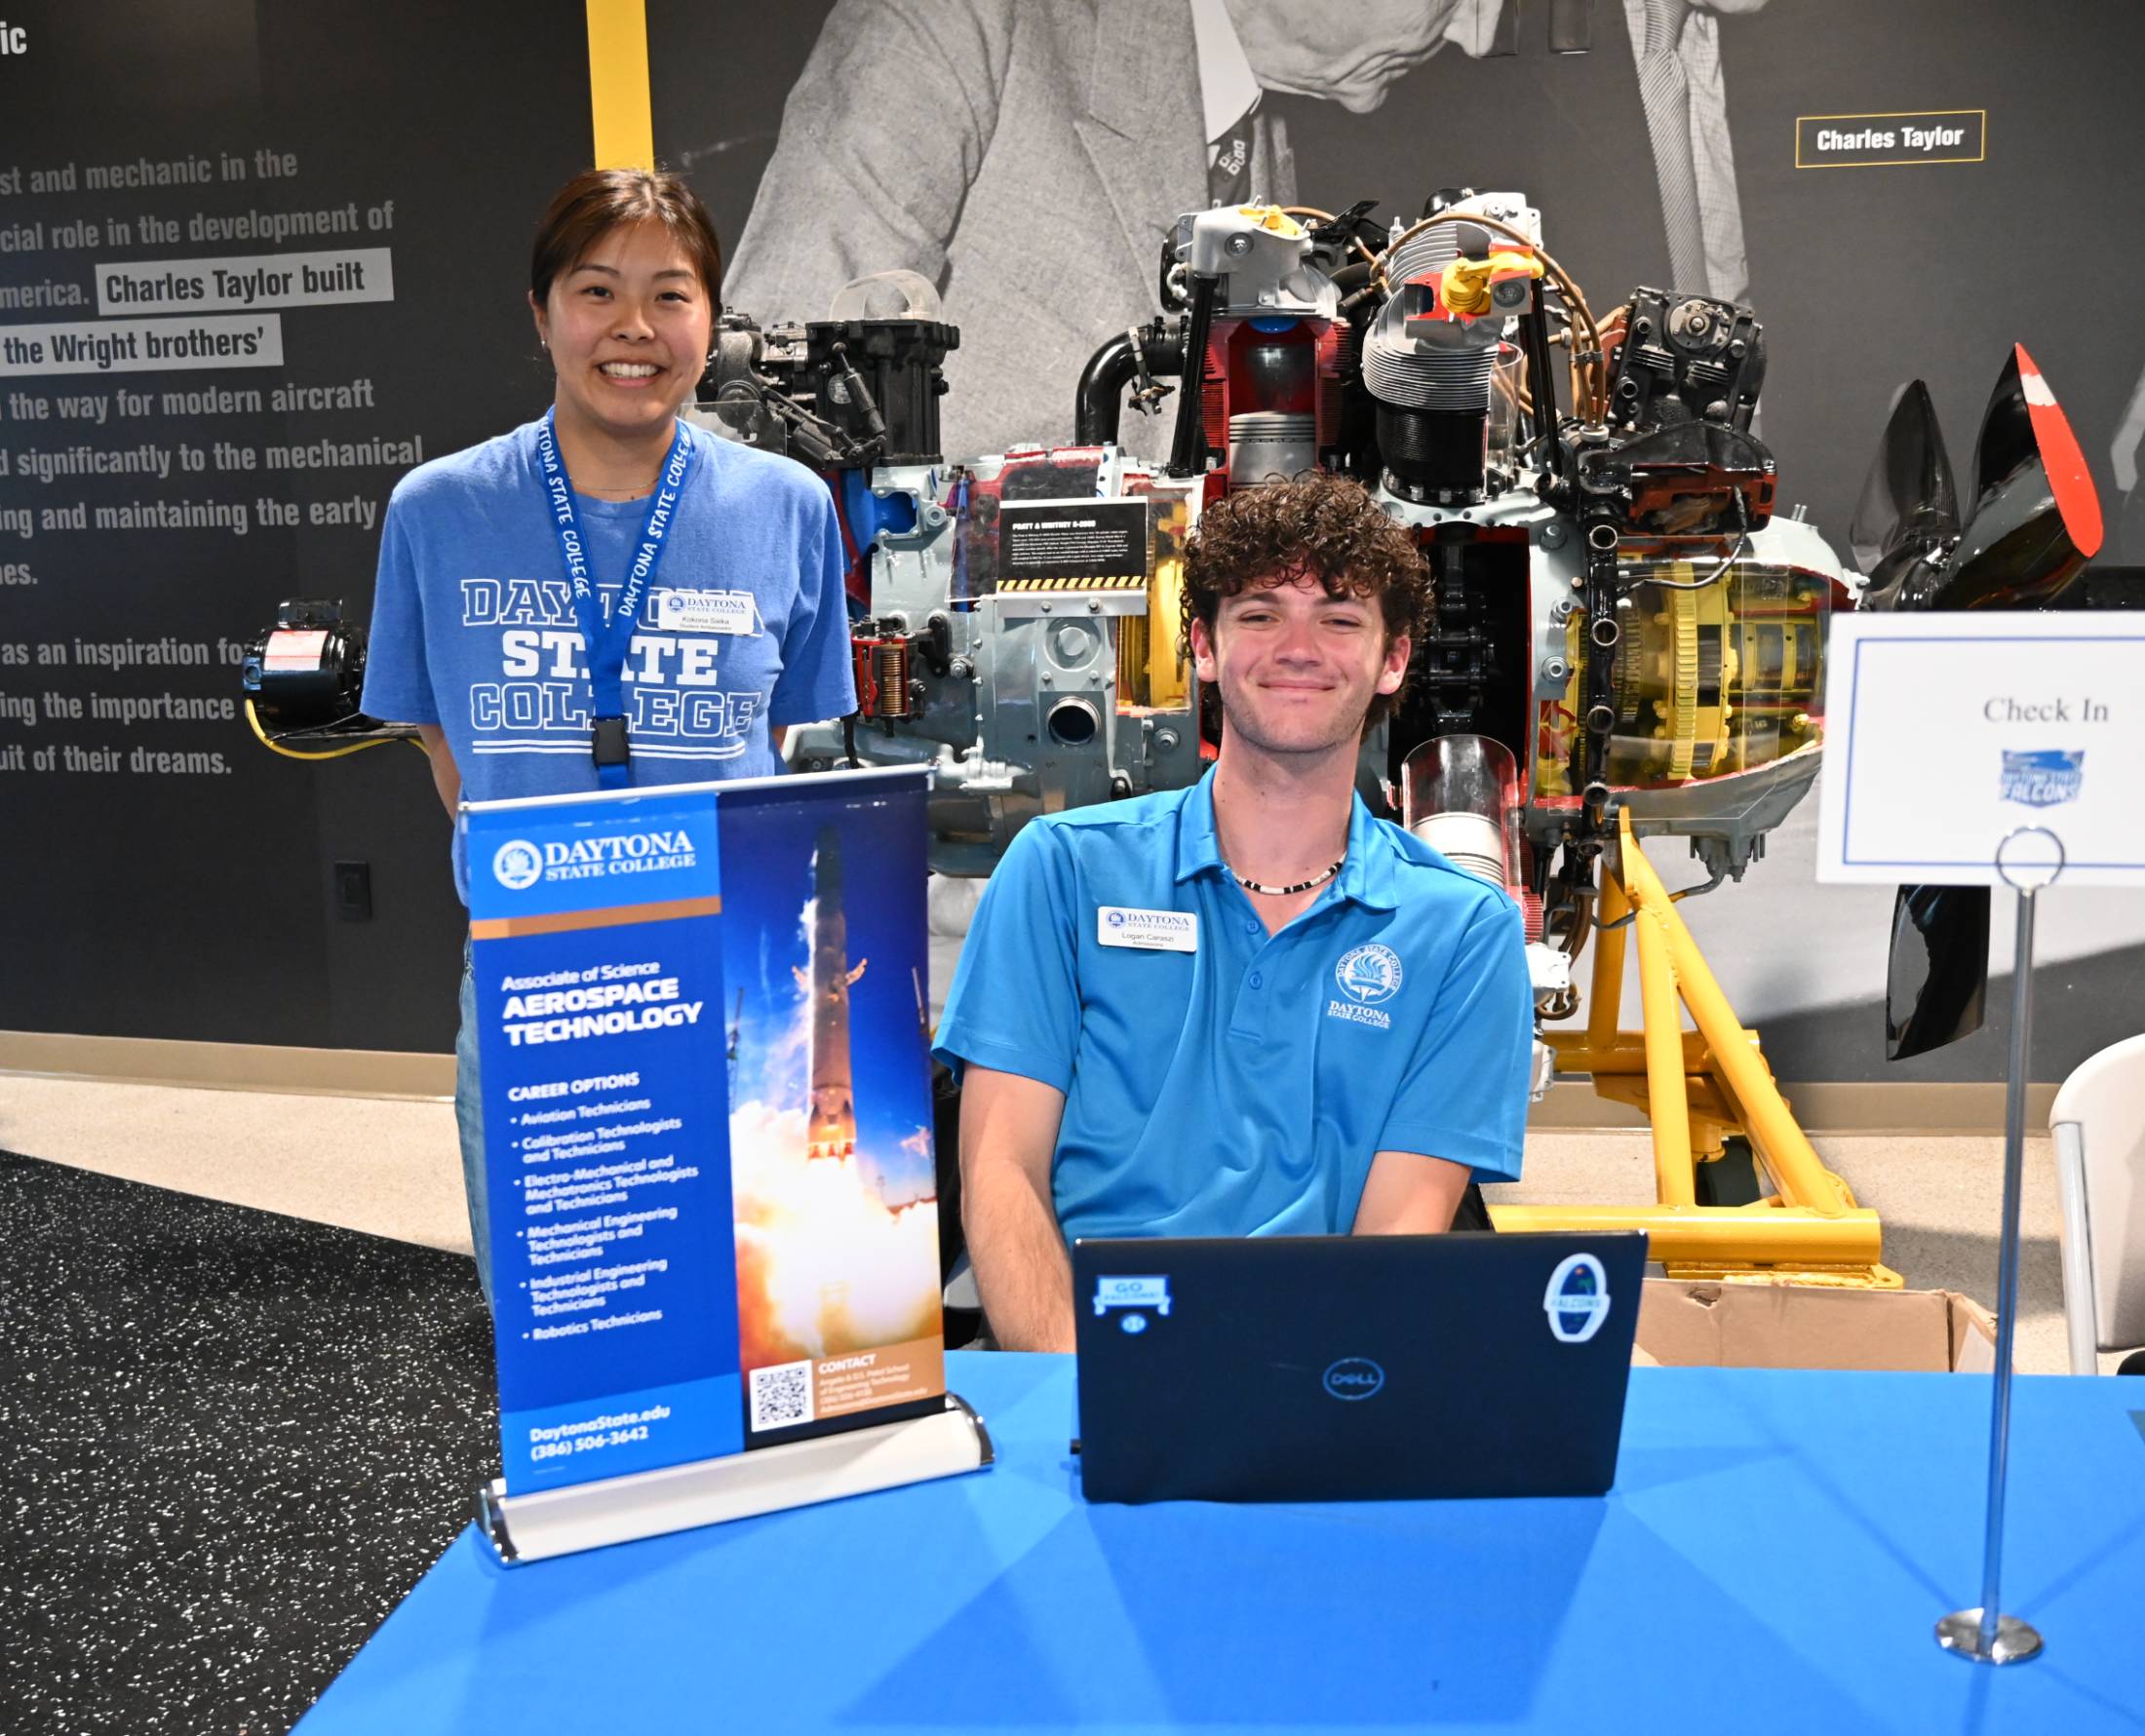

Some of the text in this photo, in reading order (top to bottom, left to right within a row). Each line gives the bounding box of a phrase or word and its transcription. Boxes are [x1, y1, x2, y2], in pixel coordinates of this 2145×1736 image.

[1816, 125, 1965, 151] Charles Taylor
[0, 148, 298, 195] st and mechanic in the
[0, 200, 395, 252] cial role in the development of
[105, 272, 205, 305] Charles
[212, 267, 293, 305] Taylor
[301, 261, 366, 293] built
[4, 326, 264, 370] the Wright brothers'
[9, 378, 375, 424] the way for modern aircraft
[18, 444, 172, 484] significantly
[179, 444, 206, 472] to
[214, 442, 257, 471] the
[265, 435, 424, 470] mechanical
[42, 502, 87, 530] and
[96, 499, 248, 535] maintaining
[255, 497, 300, 527] the
[309, 495, 377, 530] early
[548, 477, 574, 526] STATE
[563, 529, 593, 600] COLLEGE
[617, 542, 659, 618] DAYTONA
[647, 488, 677, 538] STATE
[0, 563, 38, 585] es.
[687, 598, 746, 609] DAYTONA
[1, 643, 30, 665] as
[37, 643, 67, 665] an
[75, 637, 210, 672] inspiration
[43, 692, 83, 718] the
[91, 692, 235, 725] importance
[1983, 696, 2110, 722] Check In
[33, 746, 57, 773] of
[63, 746, 122, 773] their
[130, 747, 233, 774] dreams.
[544, 829, 695, 867] DAYTONA
[545, 853, 696, 881] STATE COLLEGE
[1128, 913, 1190, 926] DAYTONA
[501, 962, 660, 992] Associate of Science
[502, 978, 680, 1019] AEROSPACE
[1329, 1000, 1390, 1022] DAYTONA
[503, 1001, 703, 1047] TECHNOLOGY
[508, 1071, 640, 1101] CAREER OPTIONS
[521, 1099, 651, 1126] Aviation Technicians
[522, 1118, 682, 1149] Calibration Technologists
[523, 1140, 626, 1164] and Technicians
[647, 1154, 674, 1169] and
[613, 1167, 699, 1187] Technologists
[526, 1191, 628, 1215] and Technicians
[617, 1223, 643, 1239] and
[527, 1246, 604, 1266] Technicians
[619, 1274, 645, 1290] and
[1115, 1282, 1143, 1292] GO
[530, 1296, 606, 1317] Technicians
[590, 1309, 663, 1331] Technicians
[819, 1353, 877, 1374] CONTACT
[1331, 1372, 1377, 1385] DELL
[529, 1405, 671, 1443] DaytonaState.edu
[530, 1425, 649, 1462] (386) 506-3642
